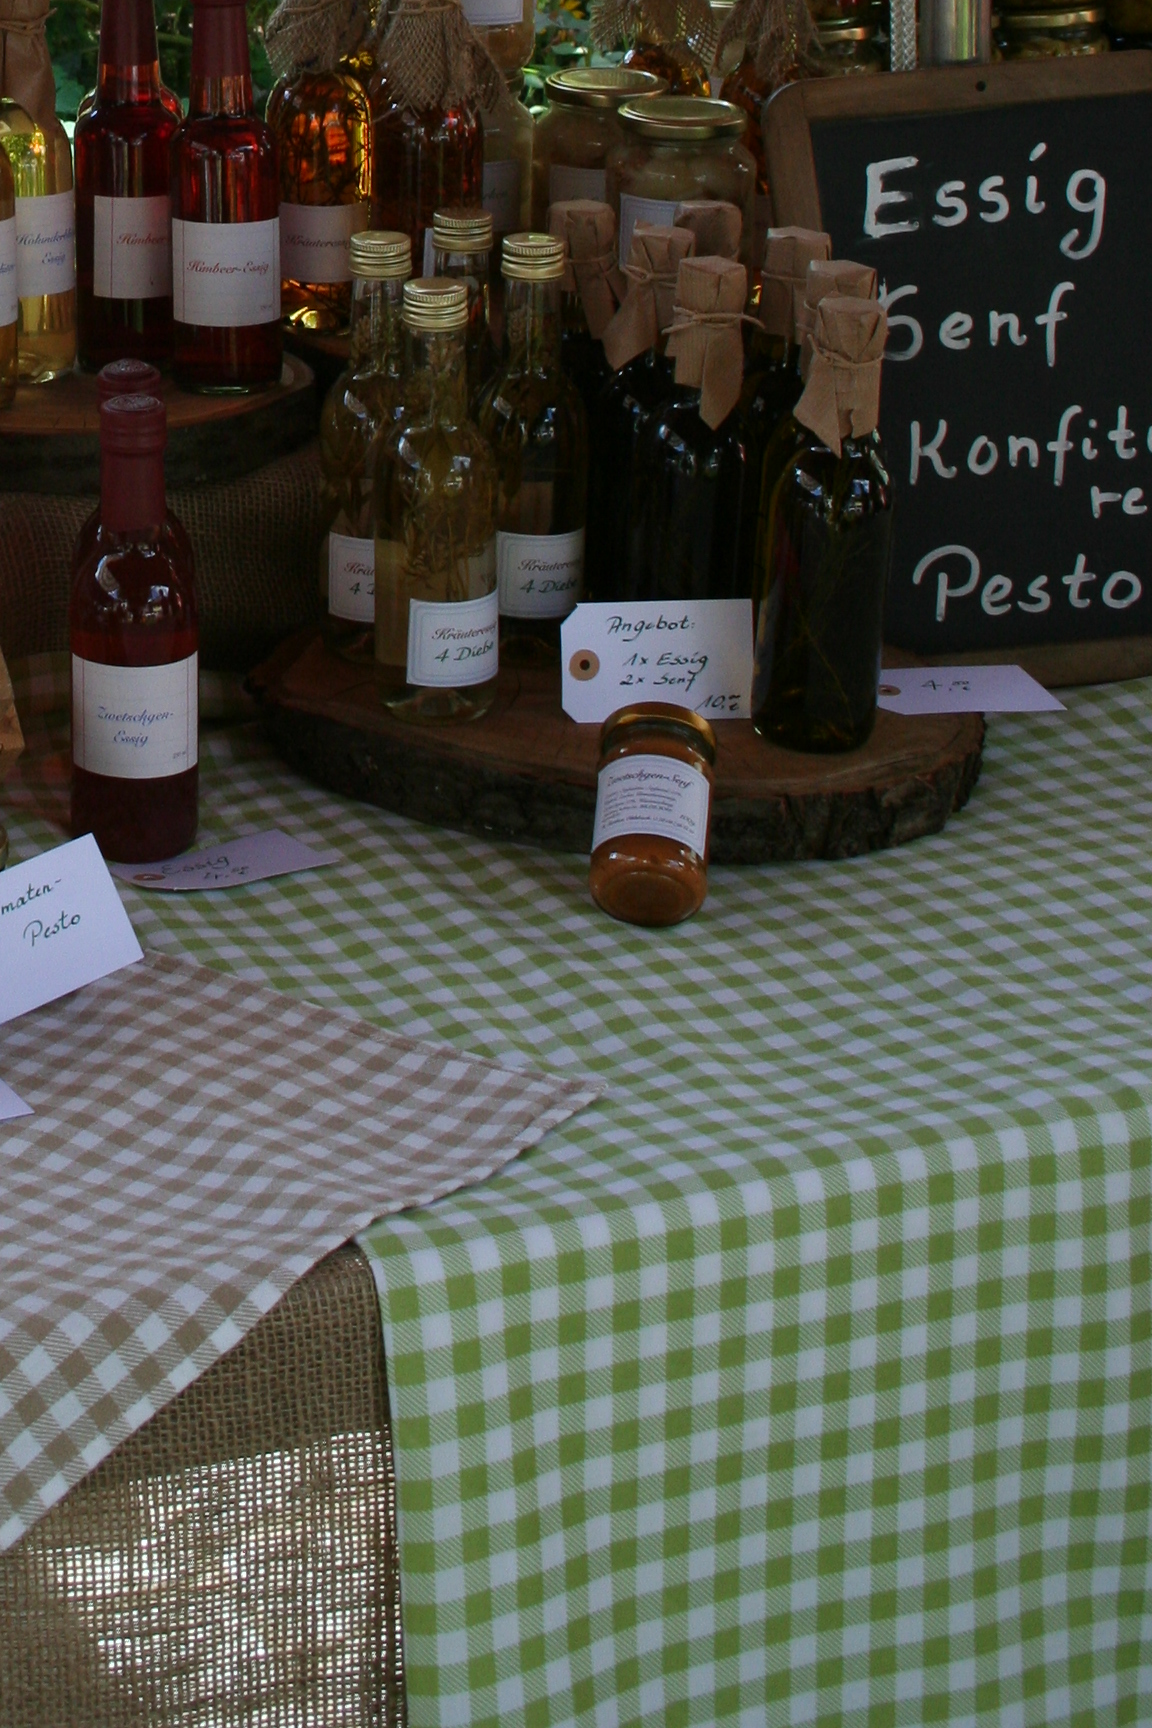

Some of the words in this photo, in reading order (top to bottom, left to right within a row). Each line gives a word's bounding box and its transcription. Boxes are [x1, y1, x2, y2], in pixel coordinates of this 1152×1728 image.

[863, 141, 1107, 260] Essig
[879, 281, 1075, 367] Senf
[909, 404, 1152, 486] Konfit
[912, 544, 1143, 623] Pesto
[434, 648, 450, 663] 4
[622, 652, 649, 666] 1x
[656, 651, 709, 674] Essig
[619, 674, 646, 686] 2x
[653, 671, 698, 693] Senf
[113, 729, 149, 748] Essig
[22, 910, 81, 947] Pesto
